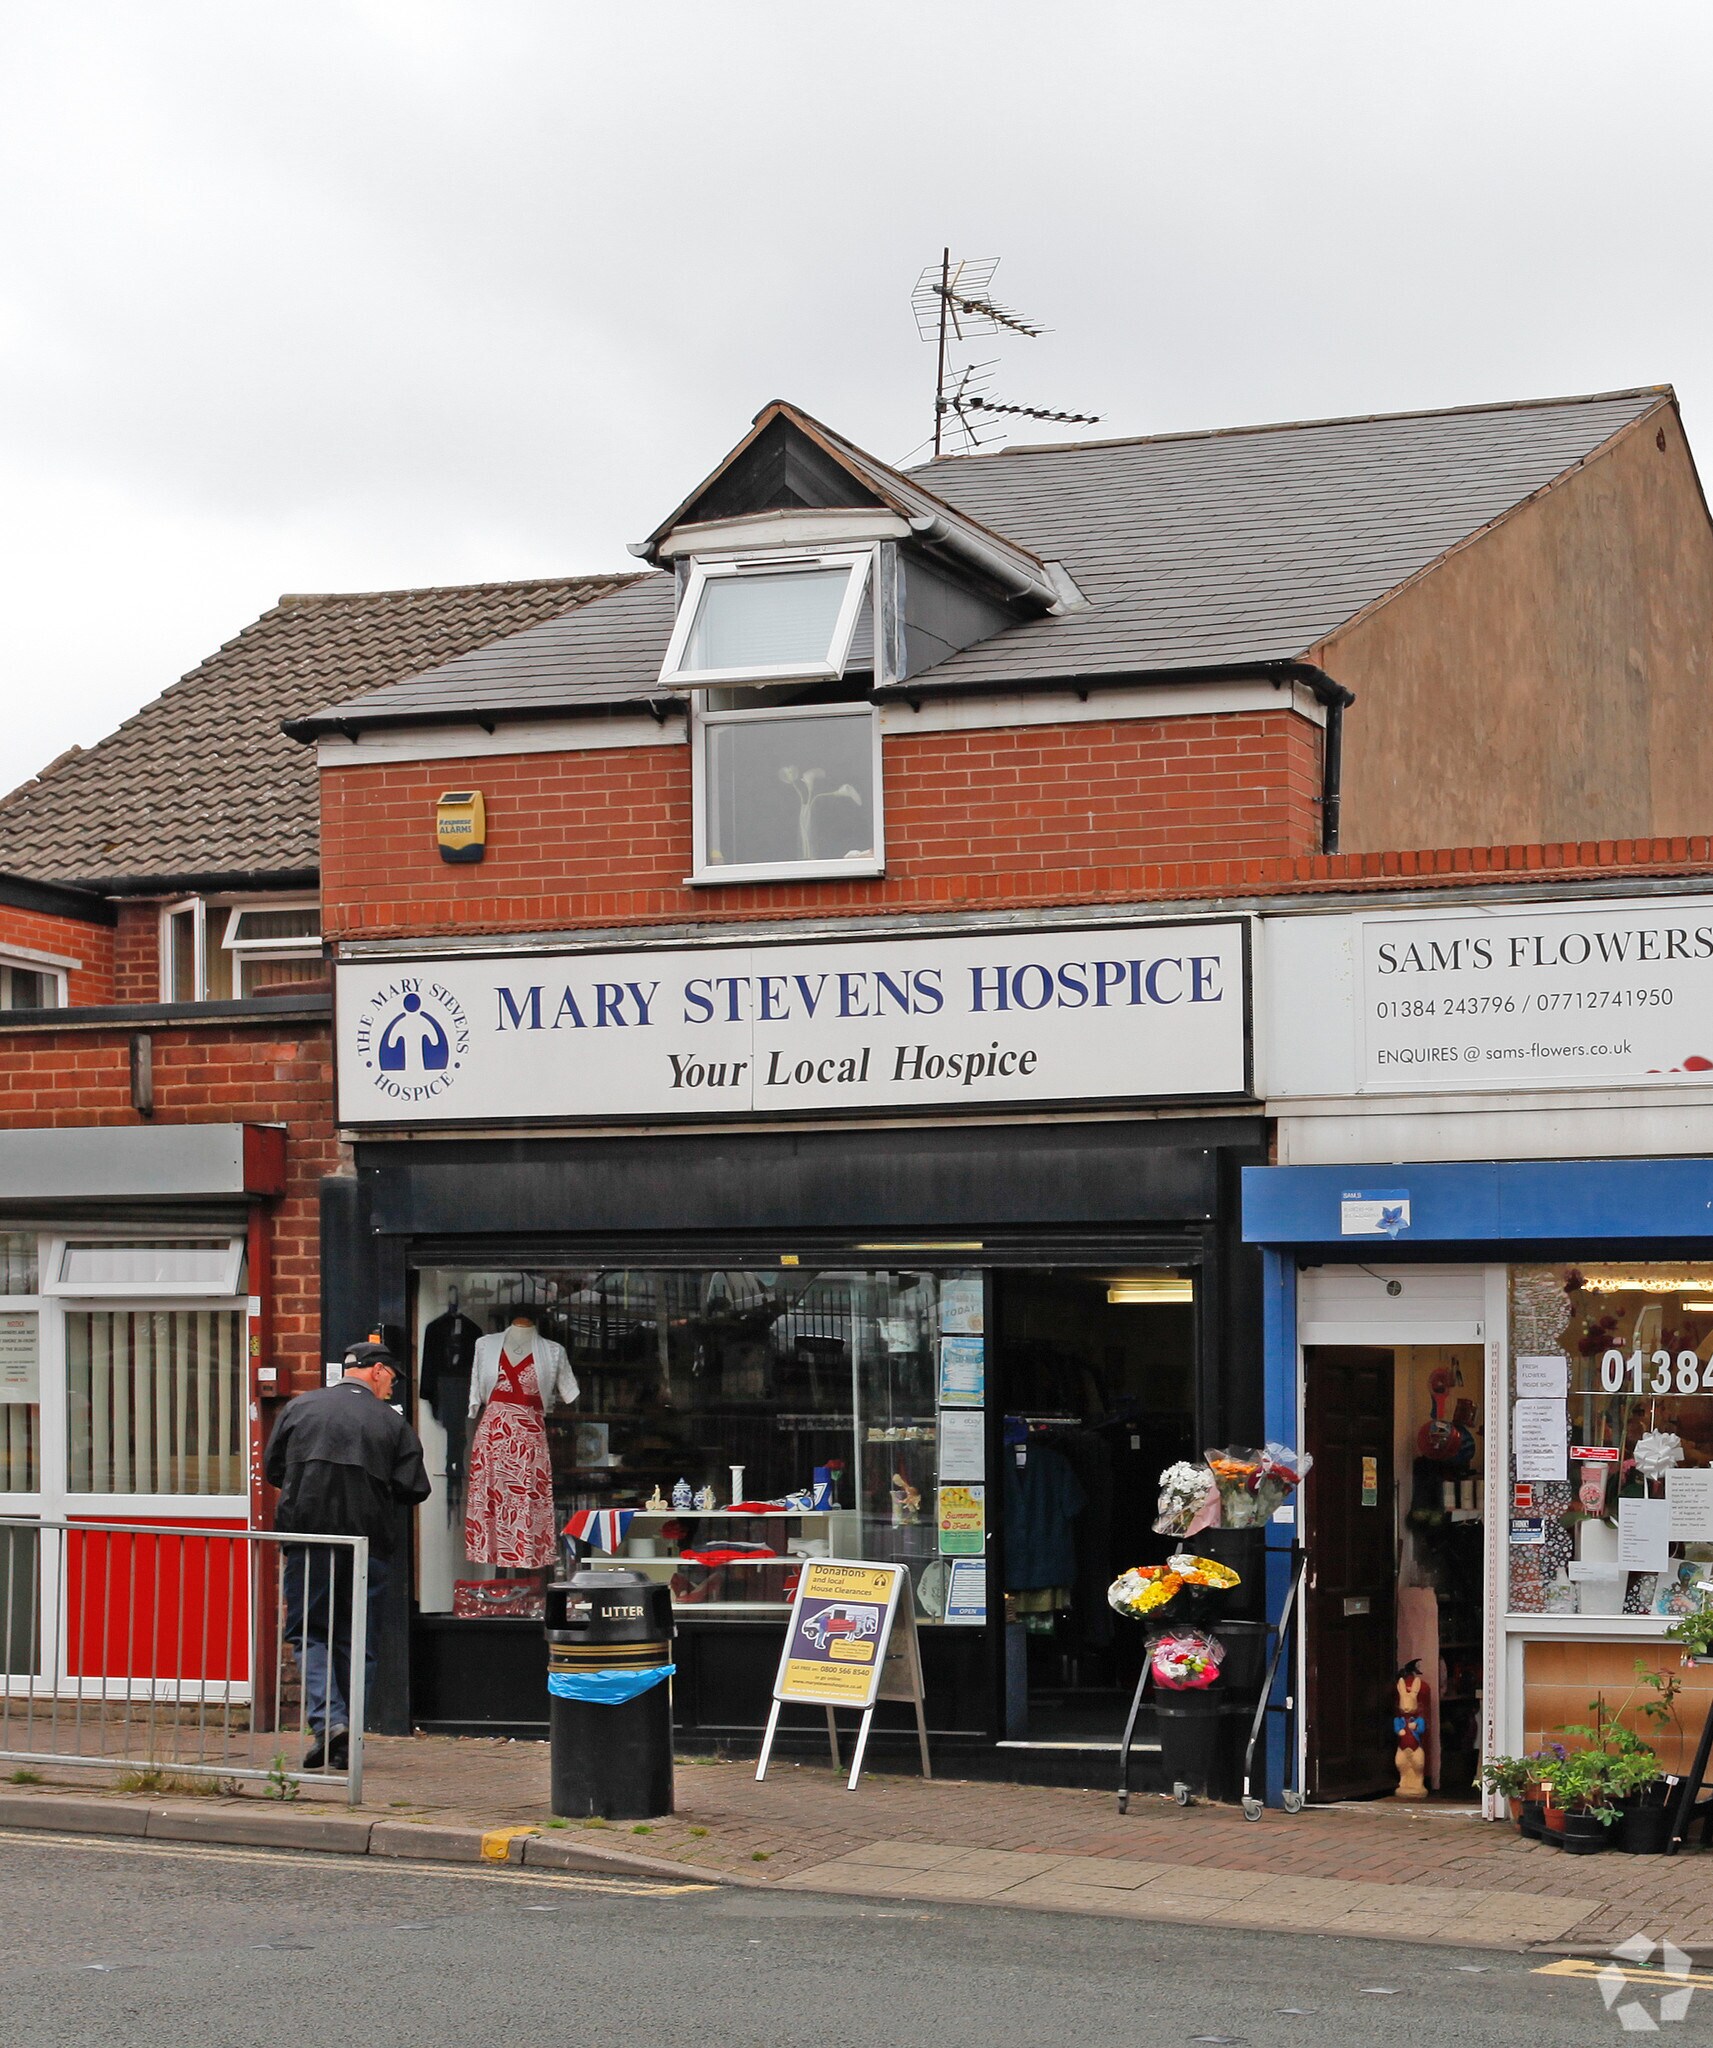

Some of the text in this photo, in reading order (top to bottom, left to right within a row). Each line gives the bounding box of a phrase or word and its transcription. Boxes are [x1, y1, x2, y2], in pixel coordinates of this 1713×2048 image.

[440, 826, 472, 834] ALARMS
[1377, 926, 1713, 975] SAM'S FLOWERS
[494, 955, 1224, 1032] MARY STEVENS HOSPICE
[1376, 999, 1436, 1019] 01384
[1443, 995, 1515, 1015] 243796
[1537, 988, 1673, 1012] 07712741950
[357, 977, 470, 1056] THE MARY STEVENS
[1377, 1039, 1632, 1064] ENQUIRES @ sams-flowers.co.uk
[667, 1041, 1037, 1090] Your Local Hospice
[374, 1071, 454, 1101] HOSPICE
[945, 1511, 978, 1519] Summer
[814, 1565, 866, 1578] Donations
[827, 1577, 845, 1585] local
[811, 1585, 872, 1596] House Clearances
[602, 1606, 644, 1618] LITTER
[820, 1665, 838, 1673] 0800
[839, 1667, 852, 1675] 566
[852, 1668, 870, 1676] 8540
